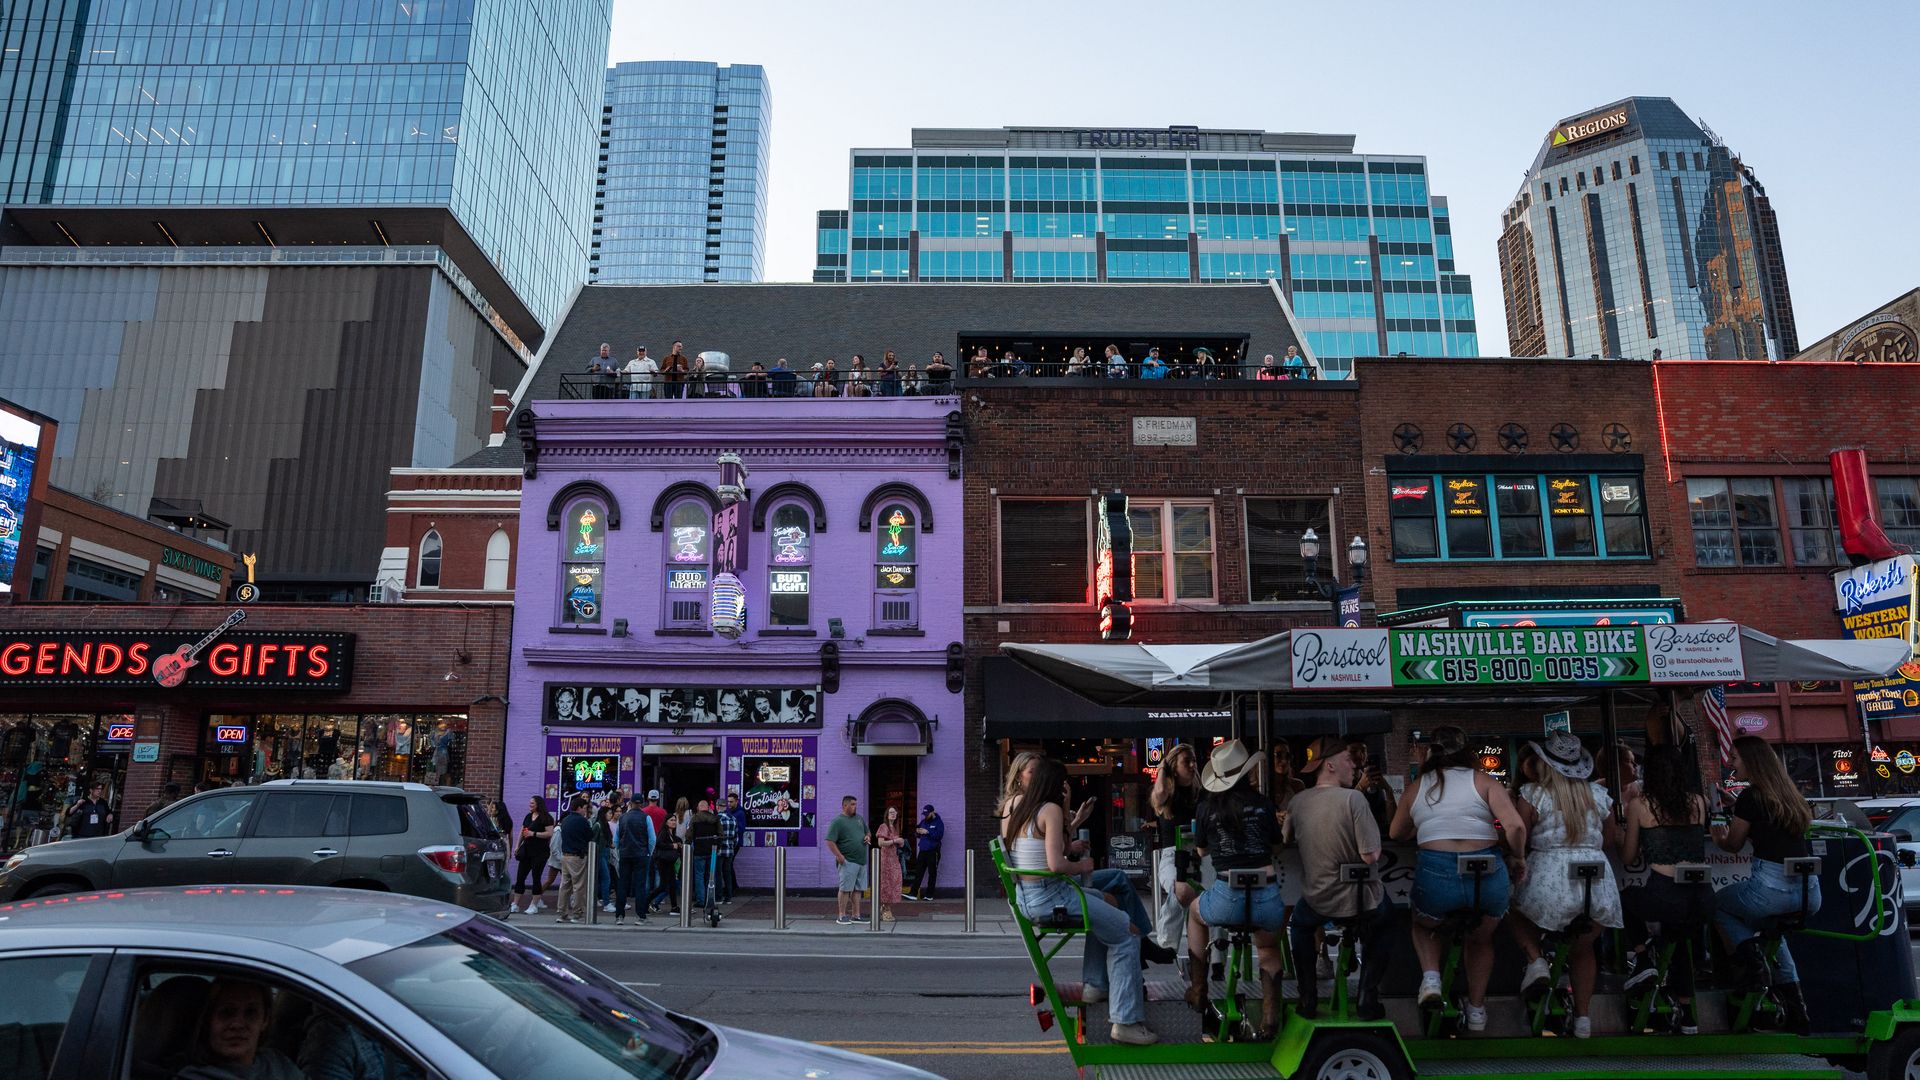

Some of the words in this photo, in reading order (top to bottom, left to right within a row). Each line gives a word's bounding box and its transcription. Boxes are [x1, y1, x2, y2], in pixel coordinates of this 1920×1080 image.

[1567, 112, 1627, 141] REGIONS
[1072, 129, 1163, 148] TRUIST
[1843, 321, 1870, 345] ROOFTOP
[1871, 314, 1892, 323] PATIO
[163, 548, 193, 571] SIXTY
[194, 560, 222, 581] VINES
[675, 572, 702, 581] BUD
[776, 574, 802, 583] BUD
[772, 582, 807, 592] LIGHT
[1840, 560, 1905, 615] Robert's
[1341, 603, 1360, 615] FANS
[1843, 605, 1909, 630] WESTERN
[1854, 623, 1902, 640] WORLD
[1398, 631, 1527, 656] NASHVILLE
[1531, 630, 1578, 655] BAR
[1583, 630, 1639, 655] BIKE
[1650, 625, 1736, 652] Barstool
[0, 643, 150, 676] GENDS
[208, 643, 329, 678] GIFTS
[1293, 632, 1388, 683] Barstool
[1331, 673, 1362, 682] NASHVILLE
[1717, 668, 1742, 677] South
[1148, 711, 1232, 719] NASHVILLE
[110, 727, 133, 738] OPE
[219, 729, 244, 740] OPEN
[220, 745, 234, 753] 424
[560, 738, 588, 753] WORLD
[590, 738, 621, 753] FAMOUS
[741, 738, 769, 753] WORLD
[771, 738, 803, 753] FAMOUS
[1833, 749, 1853, 759] Tito's
[576, 782, 603, 790] Corona
[1116, 851, 1143, 860] ROOFTOP
[1121, 859, 1138, 867] BAR
